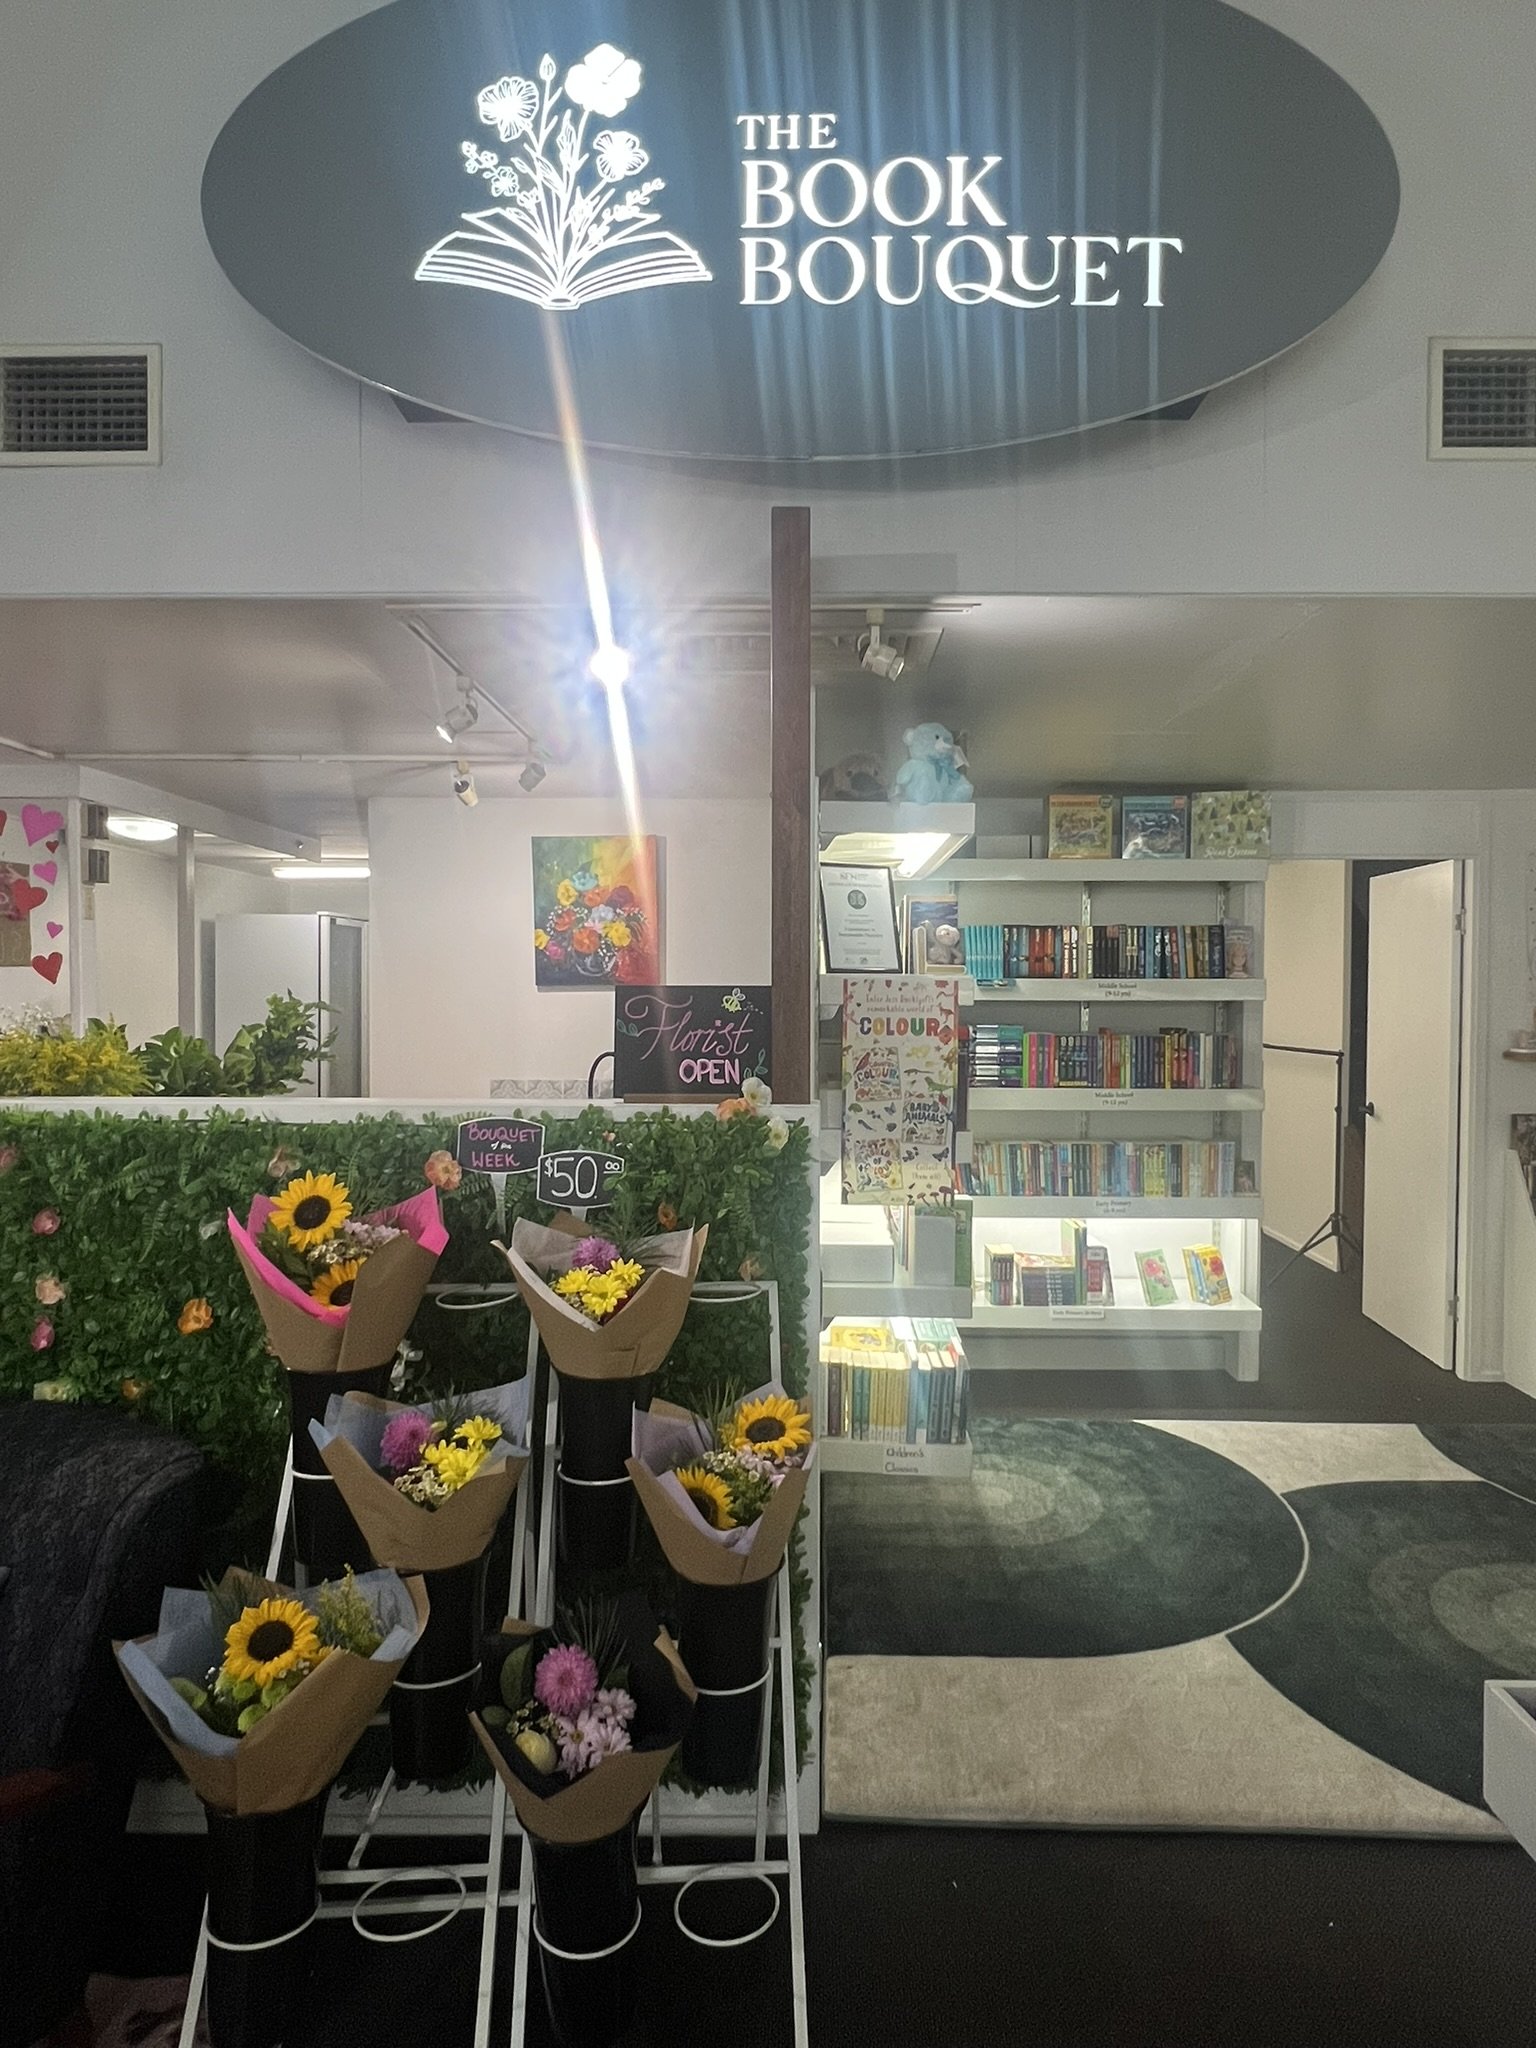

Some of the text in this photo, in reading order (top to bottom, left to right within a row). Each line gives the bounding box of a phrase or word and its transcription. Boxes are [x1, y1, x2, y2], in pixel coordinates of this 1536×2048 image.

[737, 113, 838, 150] THE
[740, 156, 1007, 229] BOOK
[739, 235, 1183, 309] BOUQUET
[625, 995, 753, 1061] Florist
[860, 1016, 940, 1037] COLOUR
[679, 1058, 741, 1085] OPEN
[910, 1102, 932, 1112] BABY
[904, 1112, 945, 1124] ANIMALS
[467, 1122, 541, 1143] BOUQUET
[471, 1151, 521, 1169] WEEK
[886, 1446, 925, 1458] Children's
